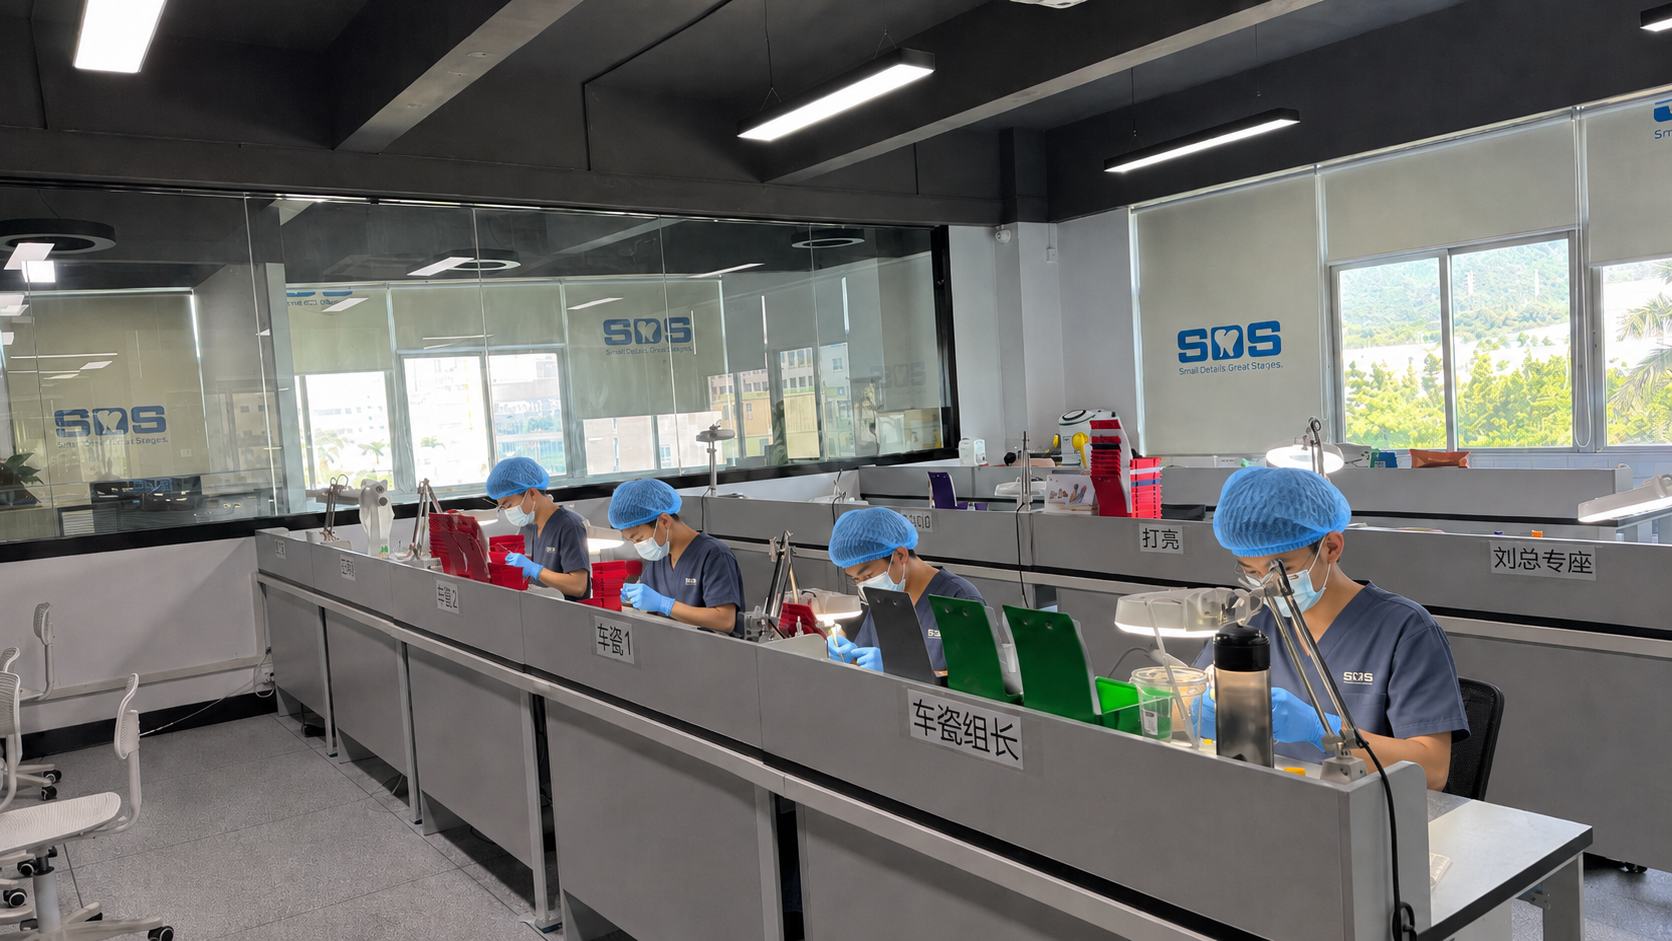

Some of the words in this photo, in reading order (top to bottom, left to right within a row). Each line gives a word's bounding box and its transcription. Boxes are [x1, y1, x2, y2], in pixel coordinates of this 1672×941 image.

[1179, 367, 1199, 375] Small
[1200, 365, 1226, 374] Details
[1228, 363, 1250, 372] Great
[1142, 527, 1180, 550] 打亮
[1493, 546, 1593, 574] 刘总专座
[597, 623, 631, 656] 车瓷1
[912, 699, 1019, 761] 车瓷组长
